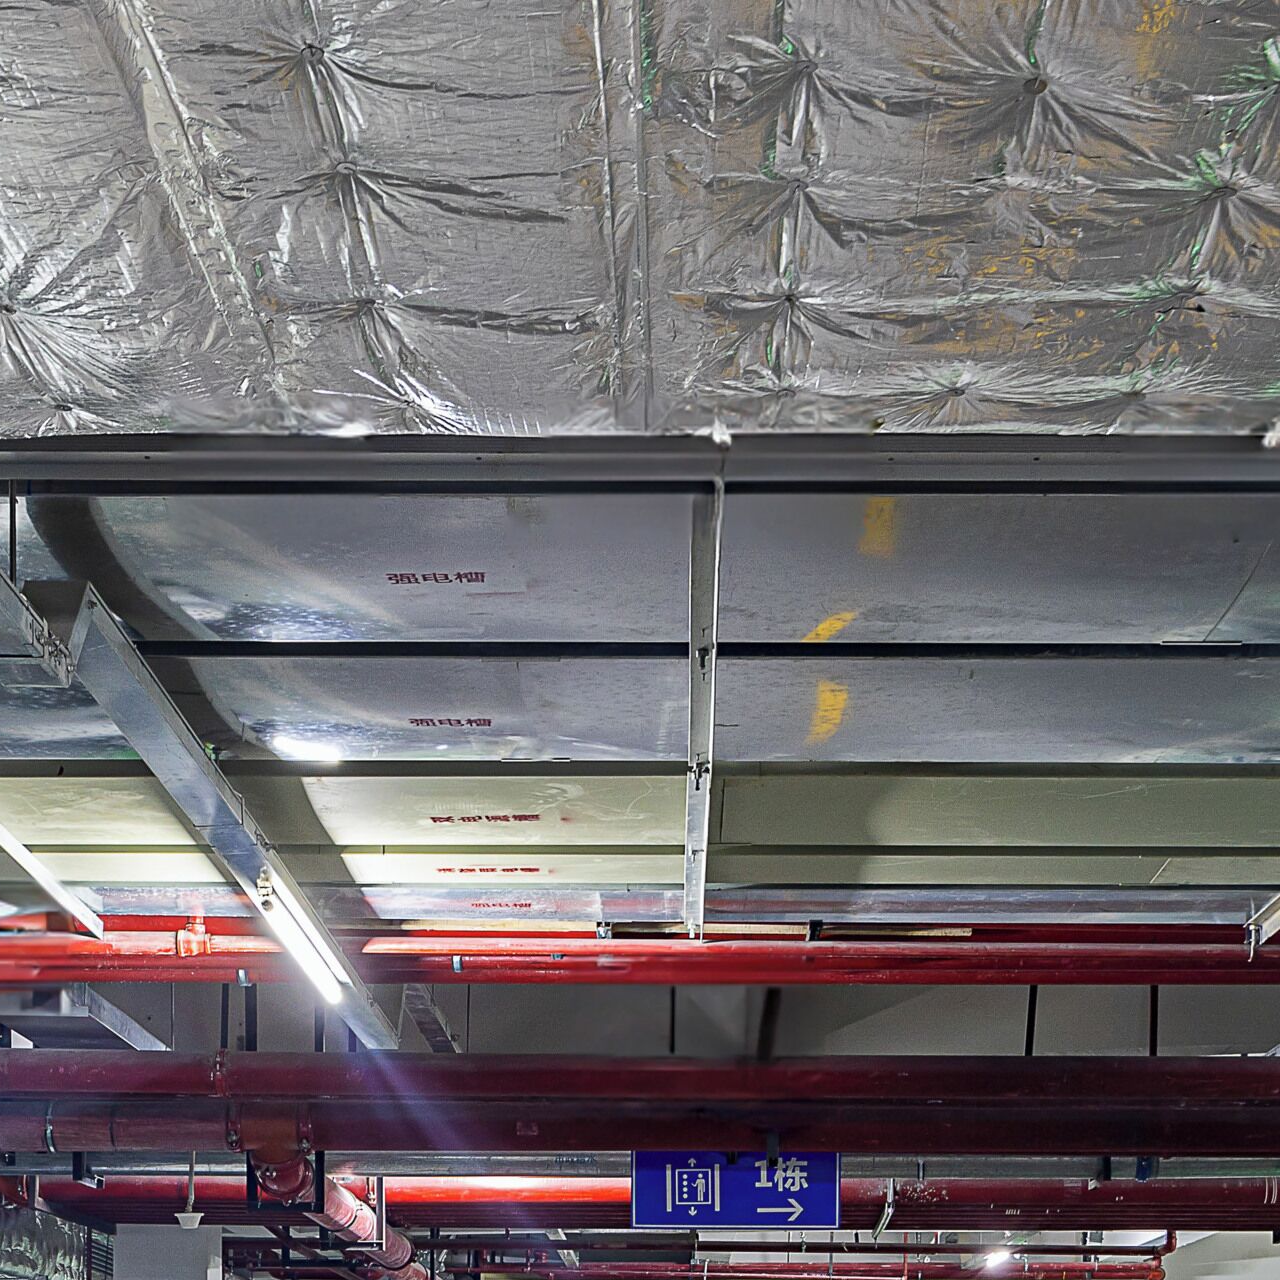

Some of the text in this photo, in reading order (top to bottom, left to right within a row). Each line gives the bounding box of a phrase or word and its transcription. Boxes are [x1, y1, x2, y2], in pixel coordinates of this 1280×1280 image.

[386, 571, 486, 585] 强电槽
[409, 718, 492, 727] 强电槽
[754, 1157, 809, 1192] 1栋
